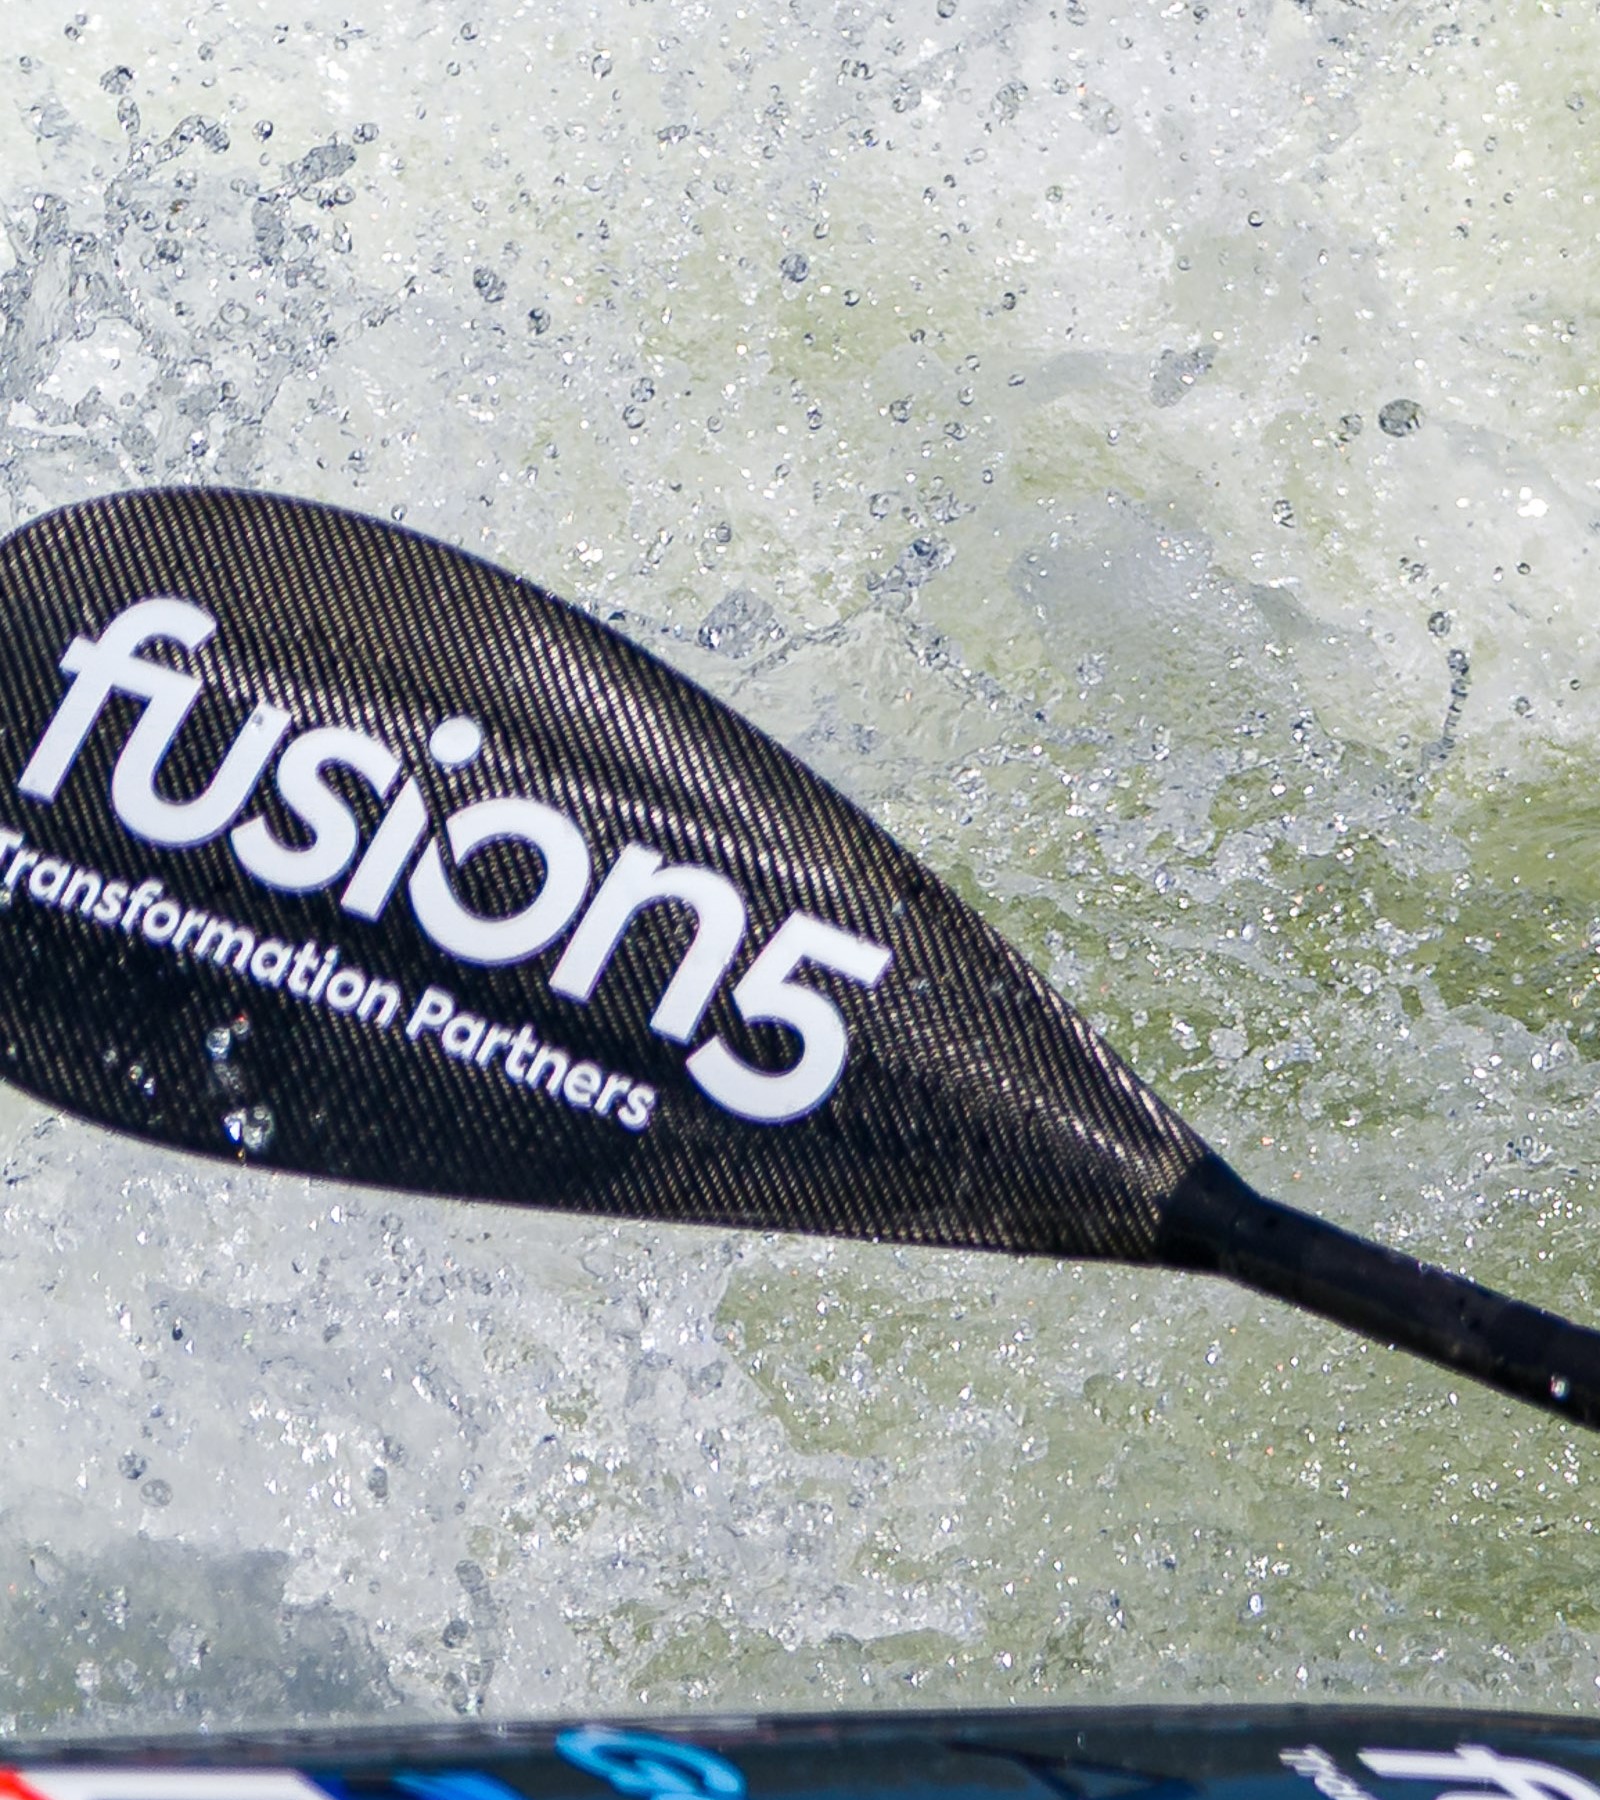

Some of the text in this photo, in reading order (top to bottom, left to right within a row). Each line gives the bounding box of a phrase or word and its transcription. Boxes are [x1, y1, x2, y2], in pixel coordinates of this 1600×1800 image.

[0, 827, 657, 1131] Transformation Partners
[17, 598, 893, 1124] fusion5
